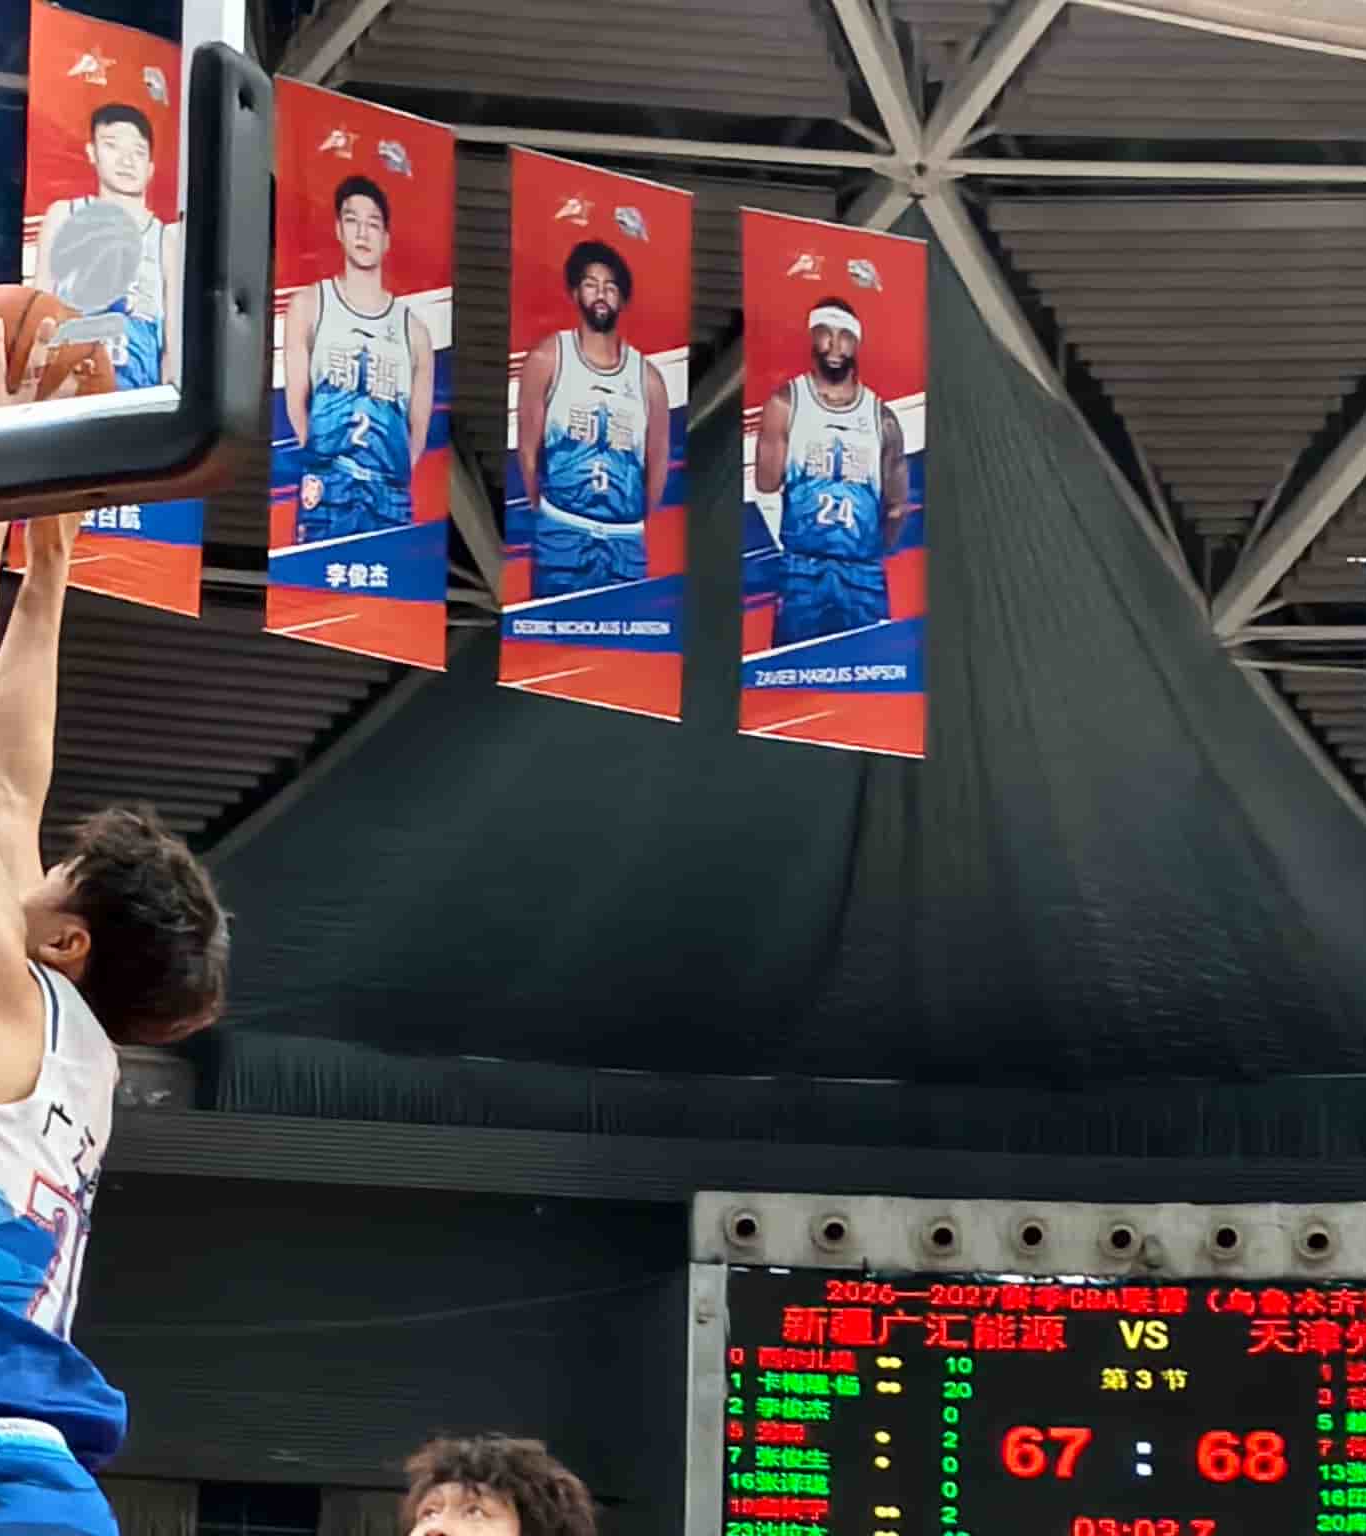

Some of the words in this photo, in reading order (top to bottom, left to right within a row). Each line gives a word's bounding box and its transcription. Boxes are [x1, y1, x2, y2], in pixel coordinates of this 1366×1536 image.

[350, 411, 370, 448] 2
[816, 494, 856, 529] 24
[325, 562, 388, 588] 李俊杰
[854, 664, 907, 682] SIMPSON
[782, 1305, 1068, 1351] 新疆广汇能源
[1119, 1319, 1170, 1351] VS
[945, 1356, 973, 1375] 10
[730, 1372, 742, 1389] 1
[1135, 1368, 1153, 1390] 3
[942, 1381, 973, 1399] 20
[728, 1397, 744, 1415] 2
[942, 1406, 959, 1424] 0
[1316, 1413, 1333, 1432] 5
[942, 1431, 959, 1449] 2
[727, 1446, 742, 1464] 7
[1001, 1425, 1093, 1480] 67
[1196, 1429, 1289, 1483] 68
[941, 1456, 959, 1474] 0
[941, 1481, 959, 1499] 0
[940, 1506, 958, 1524] 2
